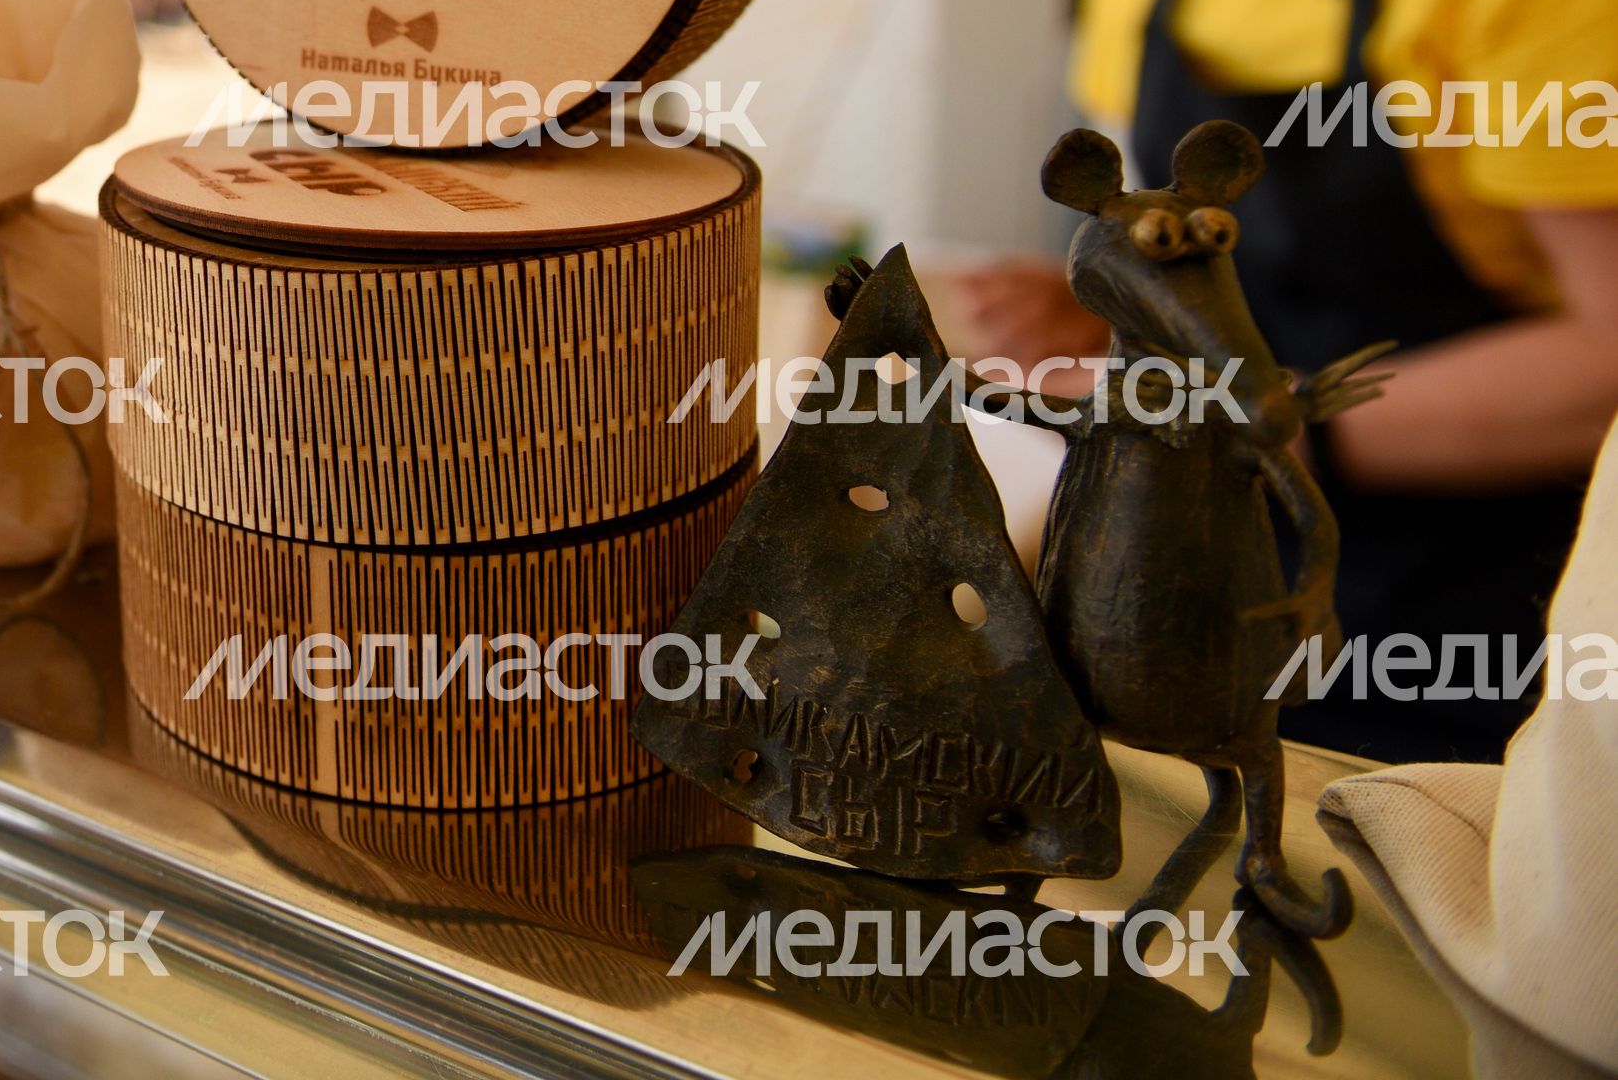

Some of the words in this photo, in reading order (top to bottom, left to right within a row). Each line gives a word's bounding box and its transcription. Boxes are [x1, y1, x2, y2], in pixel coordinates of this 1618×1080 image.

[300, 47, 406, 79] Наталья
[413, 57, 503, 87] Букина
[790, 758, 958, 857] СЫР
